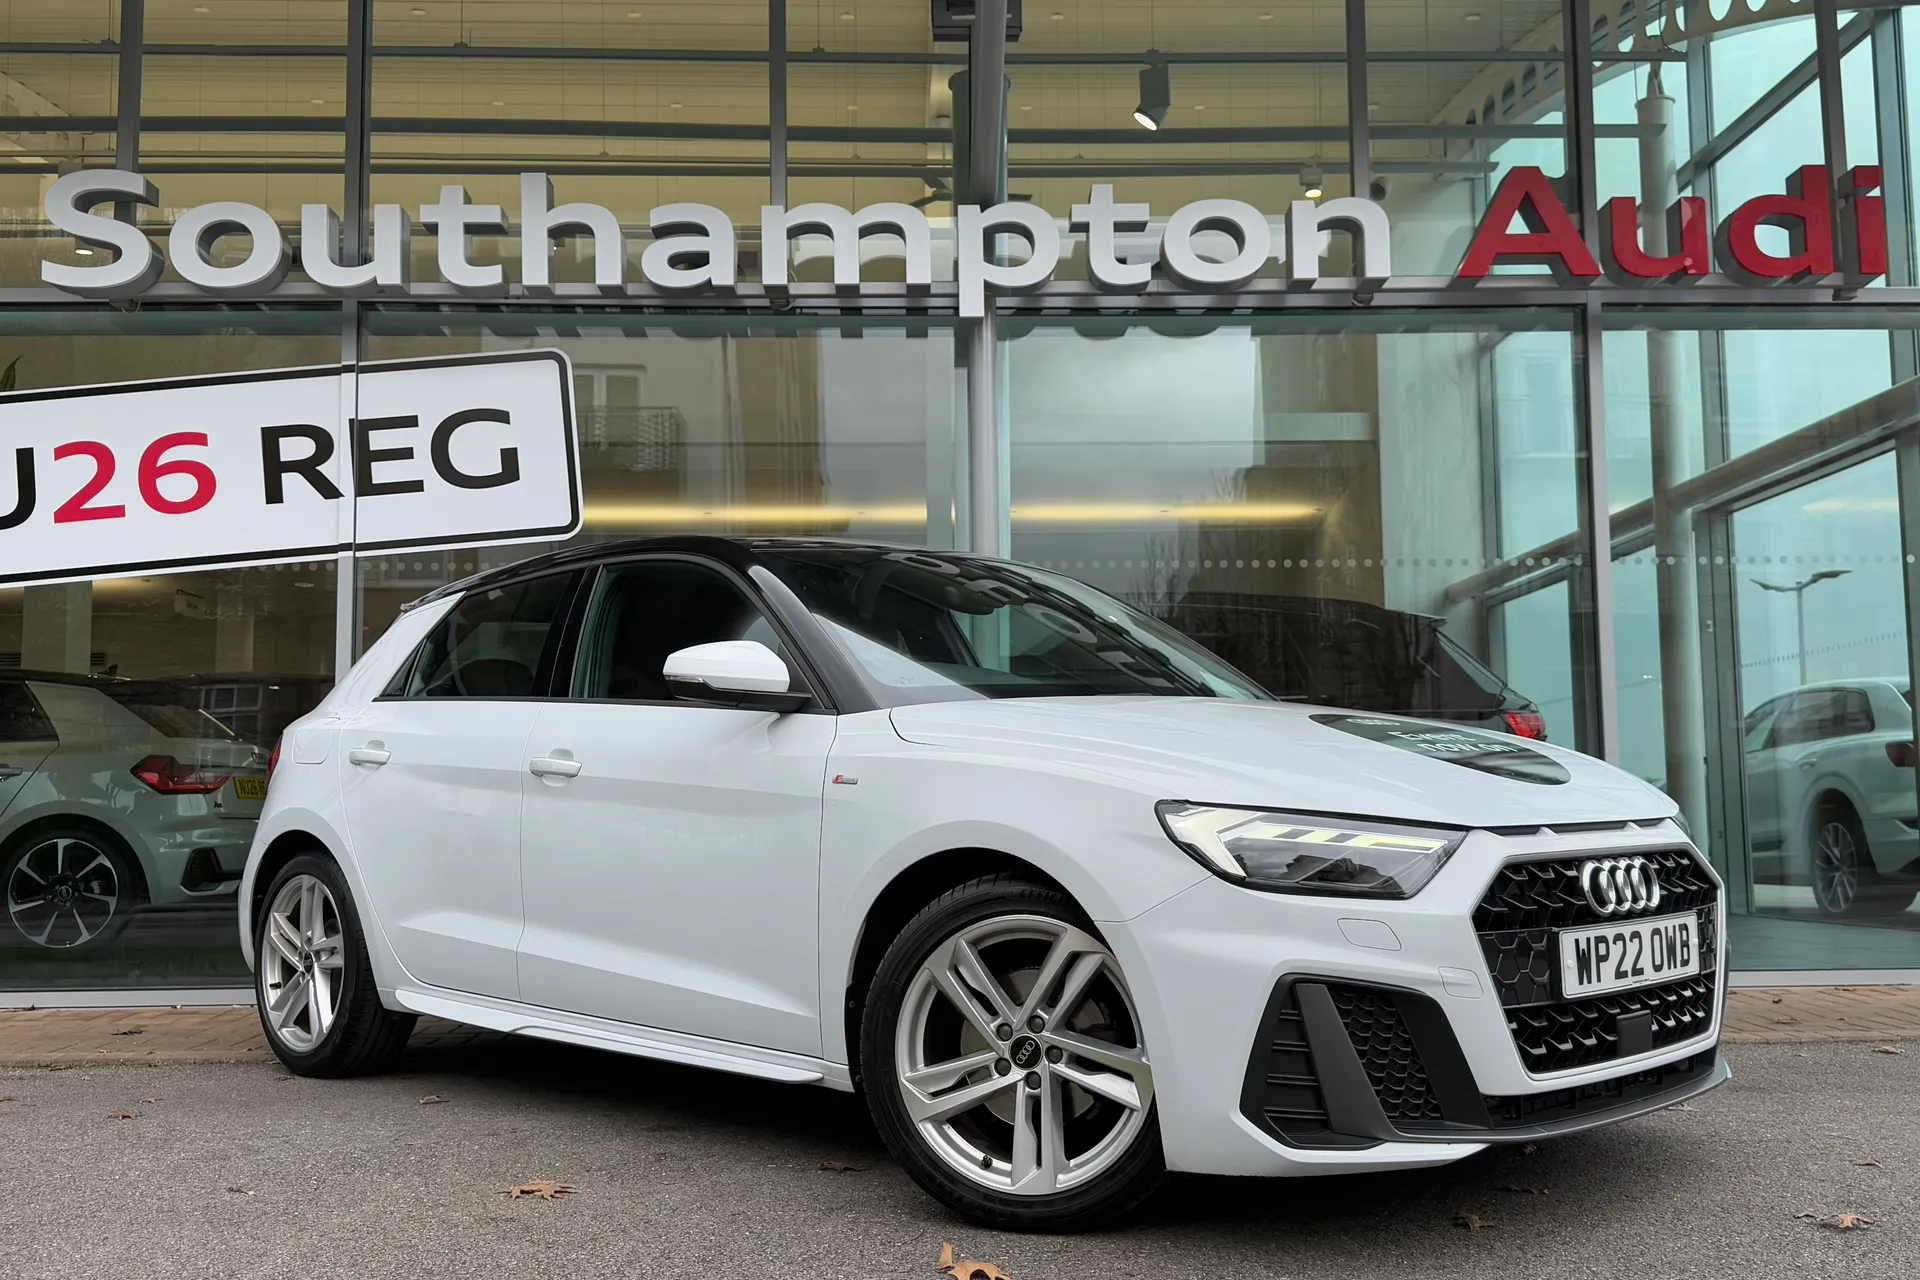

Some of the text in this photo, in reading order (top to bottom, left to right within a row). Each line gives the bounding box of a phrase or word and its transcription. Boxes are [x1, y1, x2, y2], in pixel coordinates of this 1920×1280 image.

[42, 164, 1888, 318] Southampton Audi
[261, 408, 521, 505] REG
[1574, 922, 1691, 986] WP22 OWB
